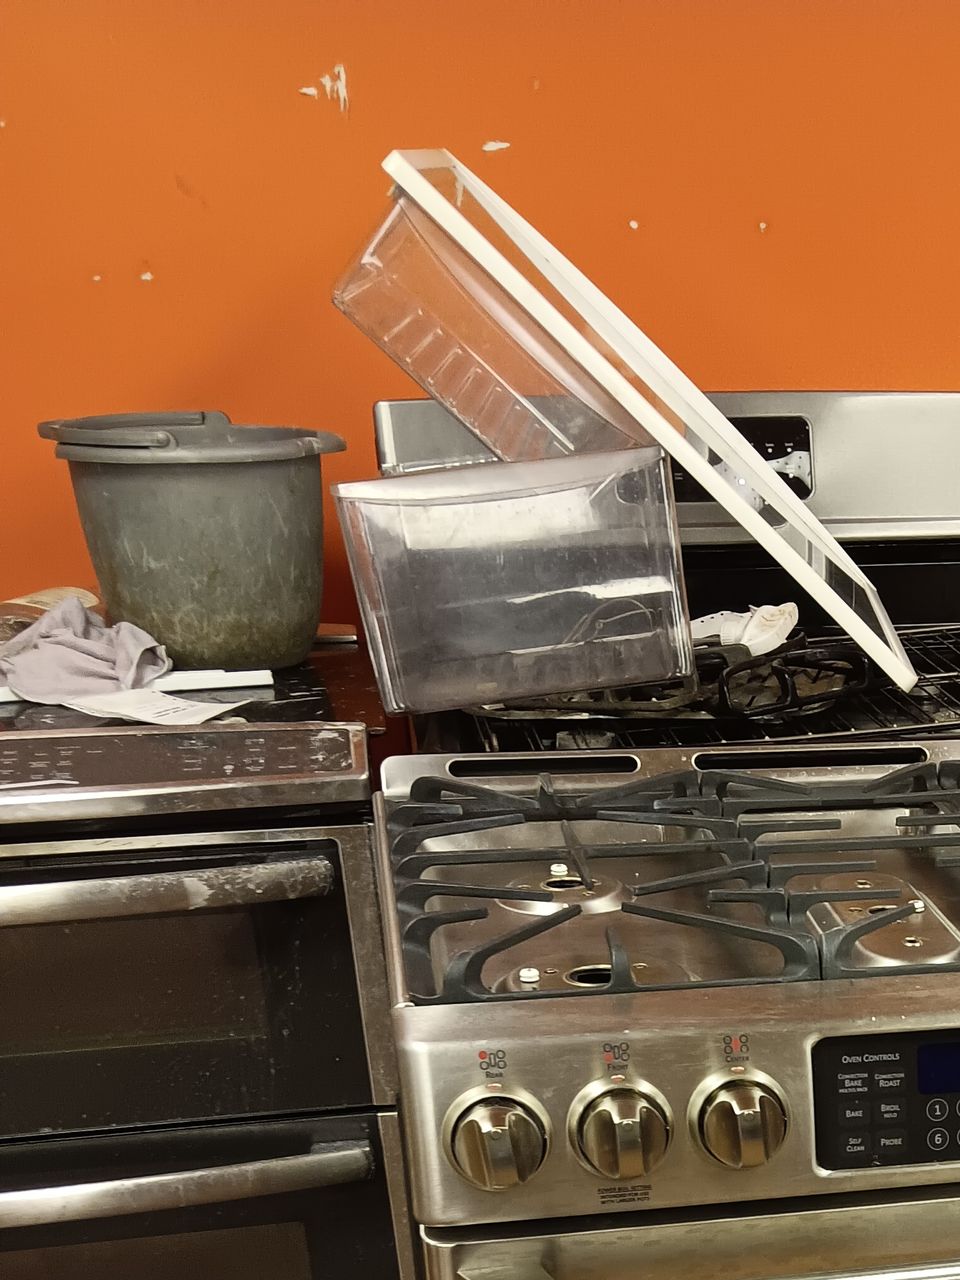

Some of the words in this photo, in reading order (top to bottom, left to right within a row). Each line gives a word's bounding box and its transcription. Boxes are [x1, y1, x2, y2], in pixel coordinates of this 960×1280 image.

[841, 1055, 862, 1063] OVEN
[863, 1053, 900, 1062] CONTROLS
[844, 1079, 862, 1087] BAKE
[879, 1079, 900, 1087] ROAST
[845, 1110, 863, 1118] BAKE
[934, 1104, 941, 1115] 1
[880, 1138, 903, 1147] PROBE
[934, 1133, 942, 1145] 6
